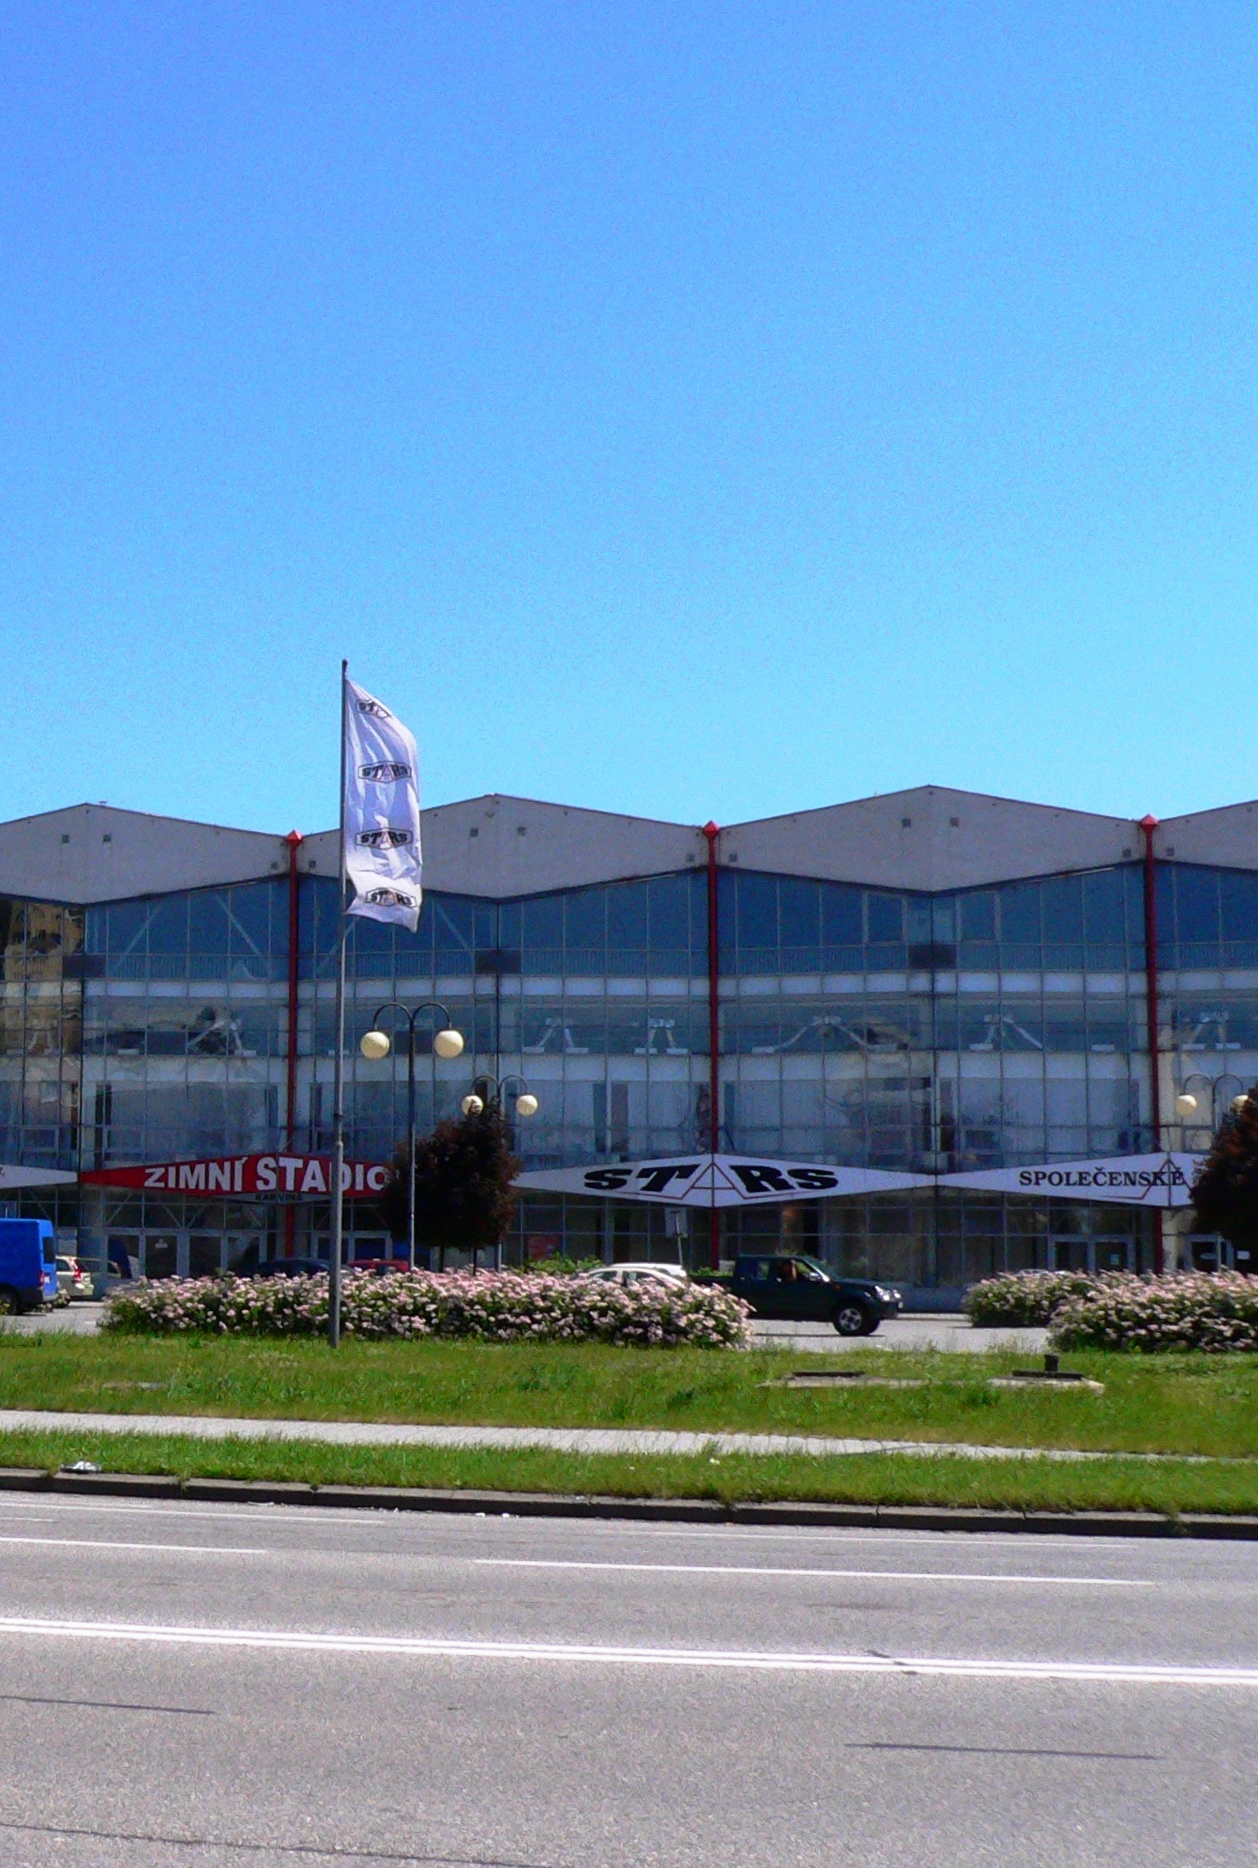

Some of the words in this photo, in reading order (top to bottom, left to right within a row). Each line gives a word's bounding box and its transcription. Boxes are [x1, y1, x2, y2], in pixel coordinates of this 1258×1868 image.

[362, 763, 409, 780] STARS
[360, 830, 408, 848] STARS
[143, 1156, 248, 1192] ZIMNÍ
[255, 1156, 392, 1193] STADIO
[583, 1163, 839, 1200] STARS
[1018, 1166, 1186, 1187] SPOLEČENSKÉ
